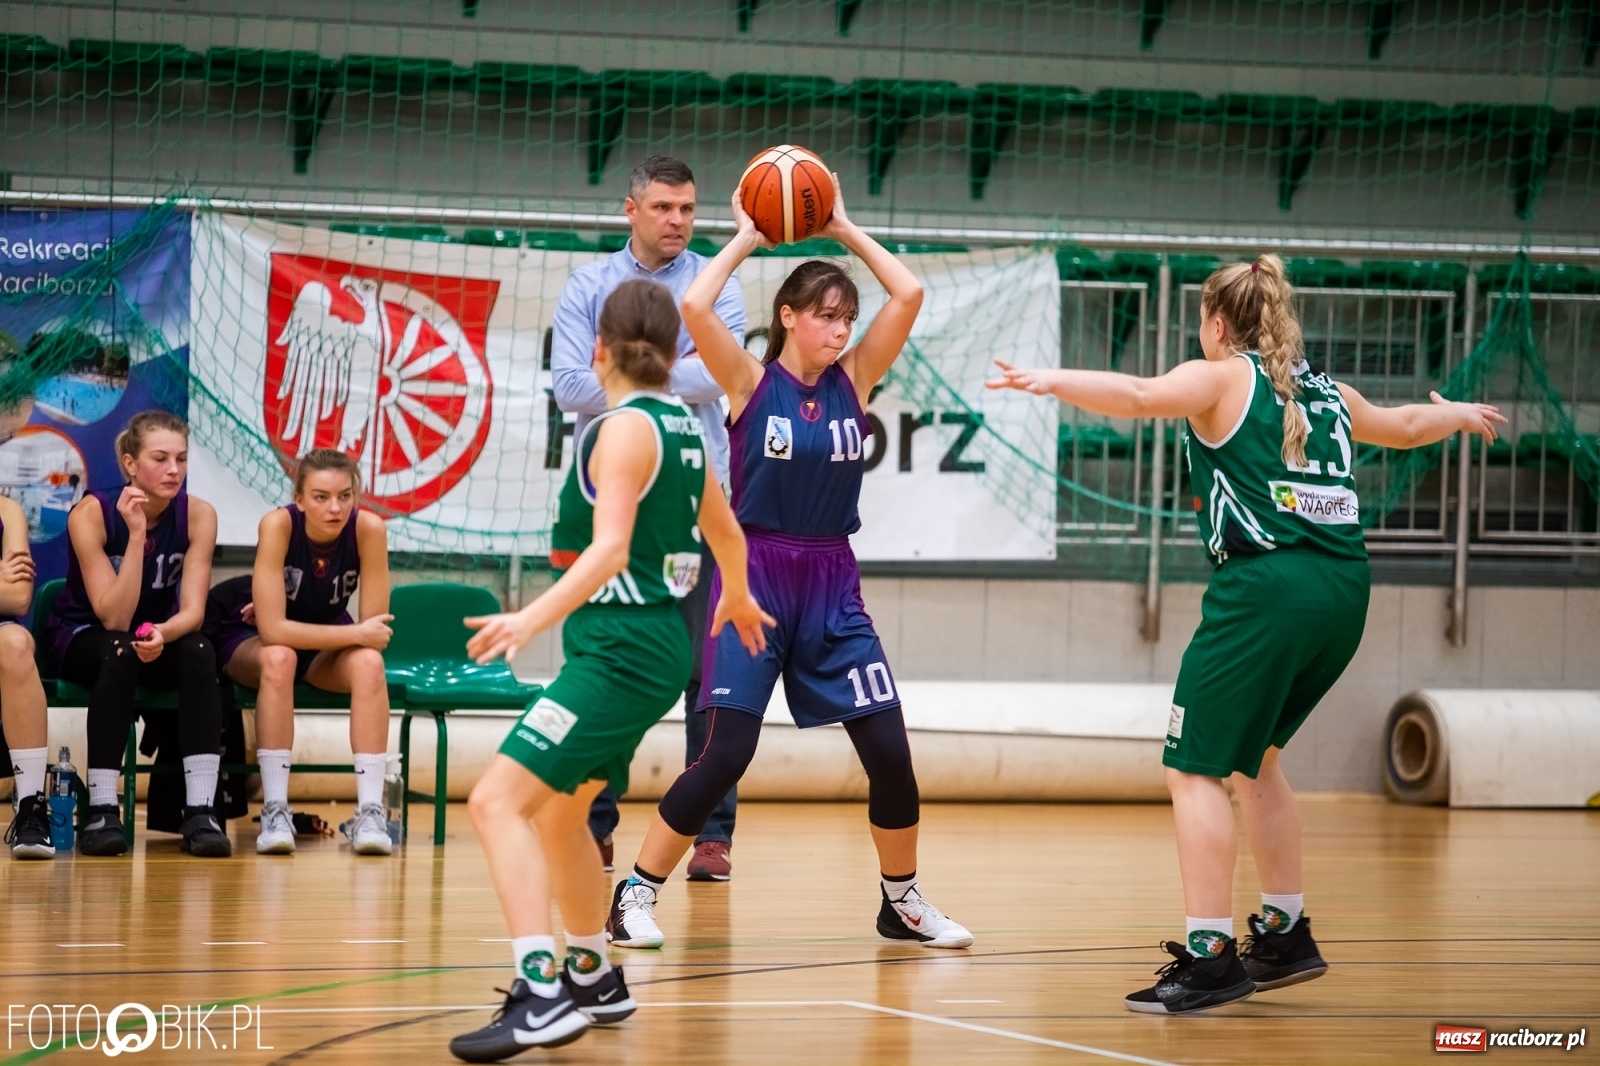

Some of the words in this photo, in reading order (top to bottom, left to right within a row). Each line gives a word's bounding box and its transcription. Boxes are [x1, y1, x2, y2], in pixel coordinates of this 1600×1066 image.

[828, 418, 861, 461] 10
[152, 553, 184, 589] 12
[847, 662, 896, 707] 10
